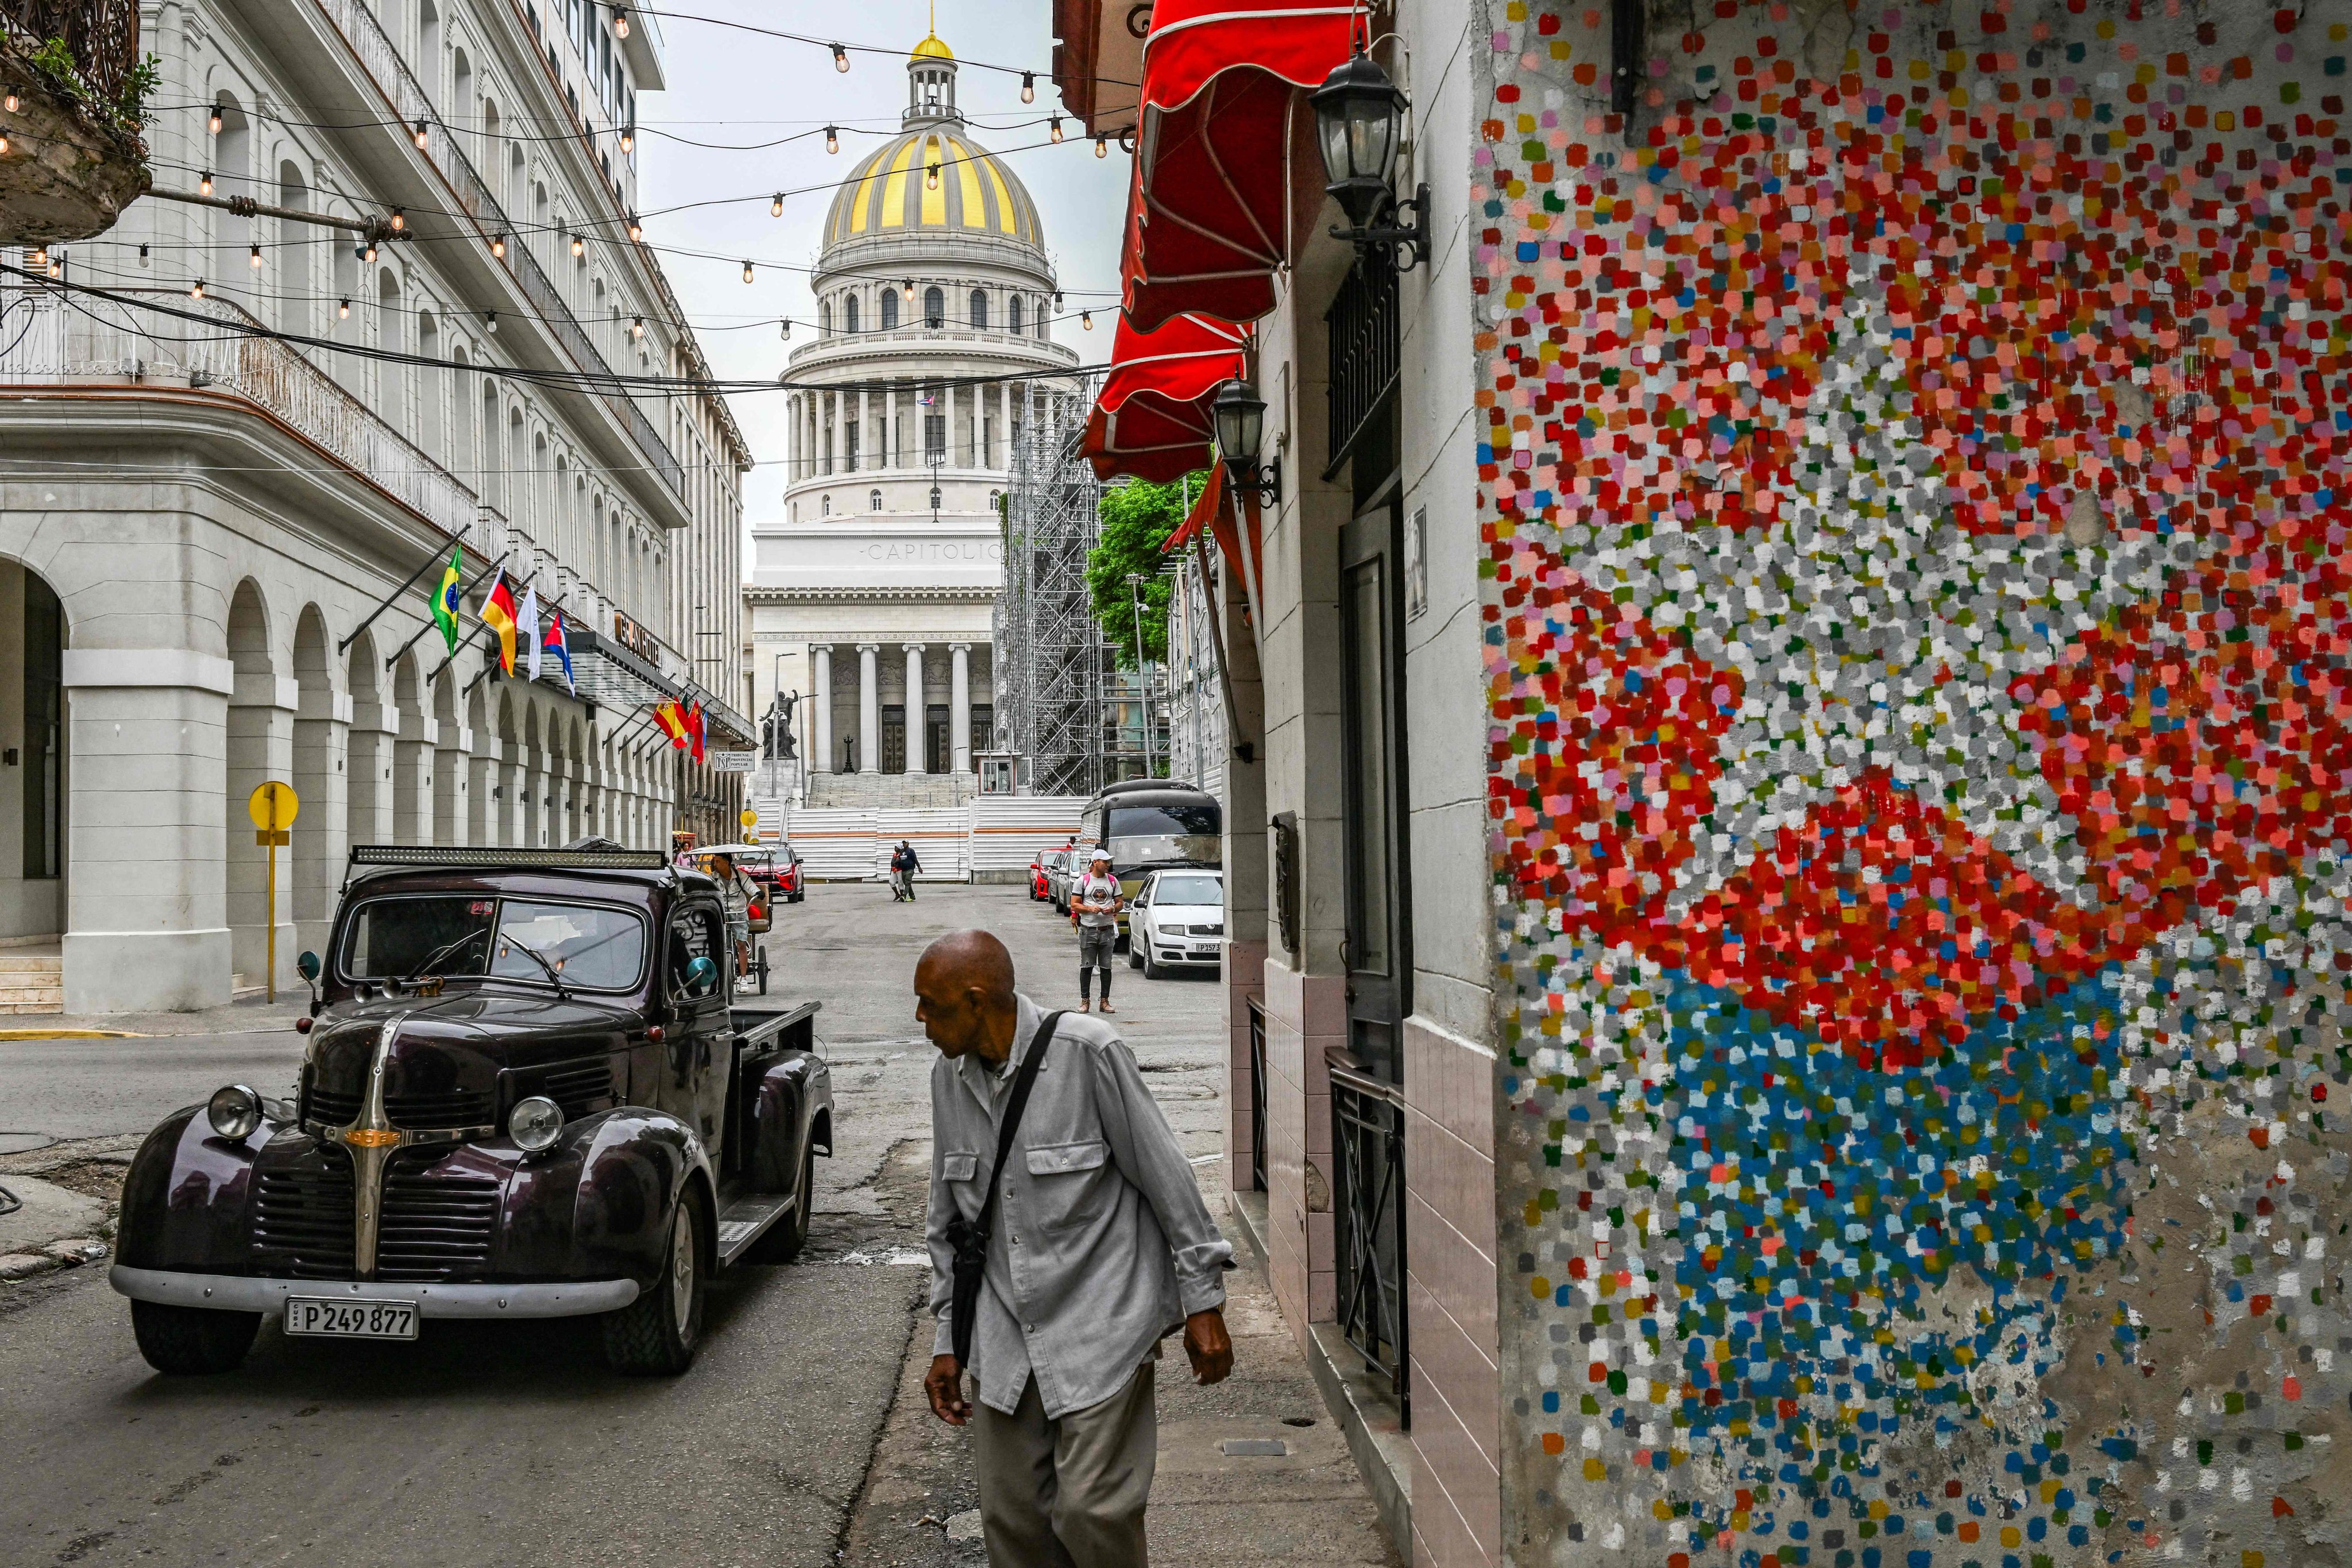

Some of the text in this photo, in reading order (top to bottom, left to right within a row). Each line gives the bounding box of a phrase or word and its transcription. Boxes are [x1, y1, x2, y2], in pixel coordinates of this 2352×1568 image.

[868, 544, 1002, 561] CAPITOLIO
[621, 613, 642, 654] GRAN
[345, 1131, 400, 1143] DODGE
